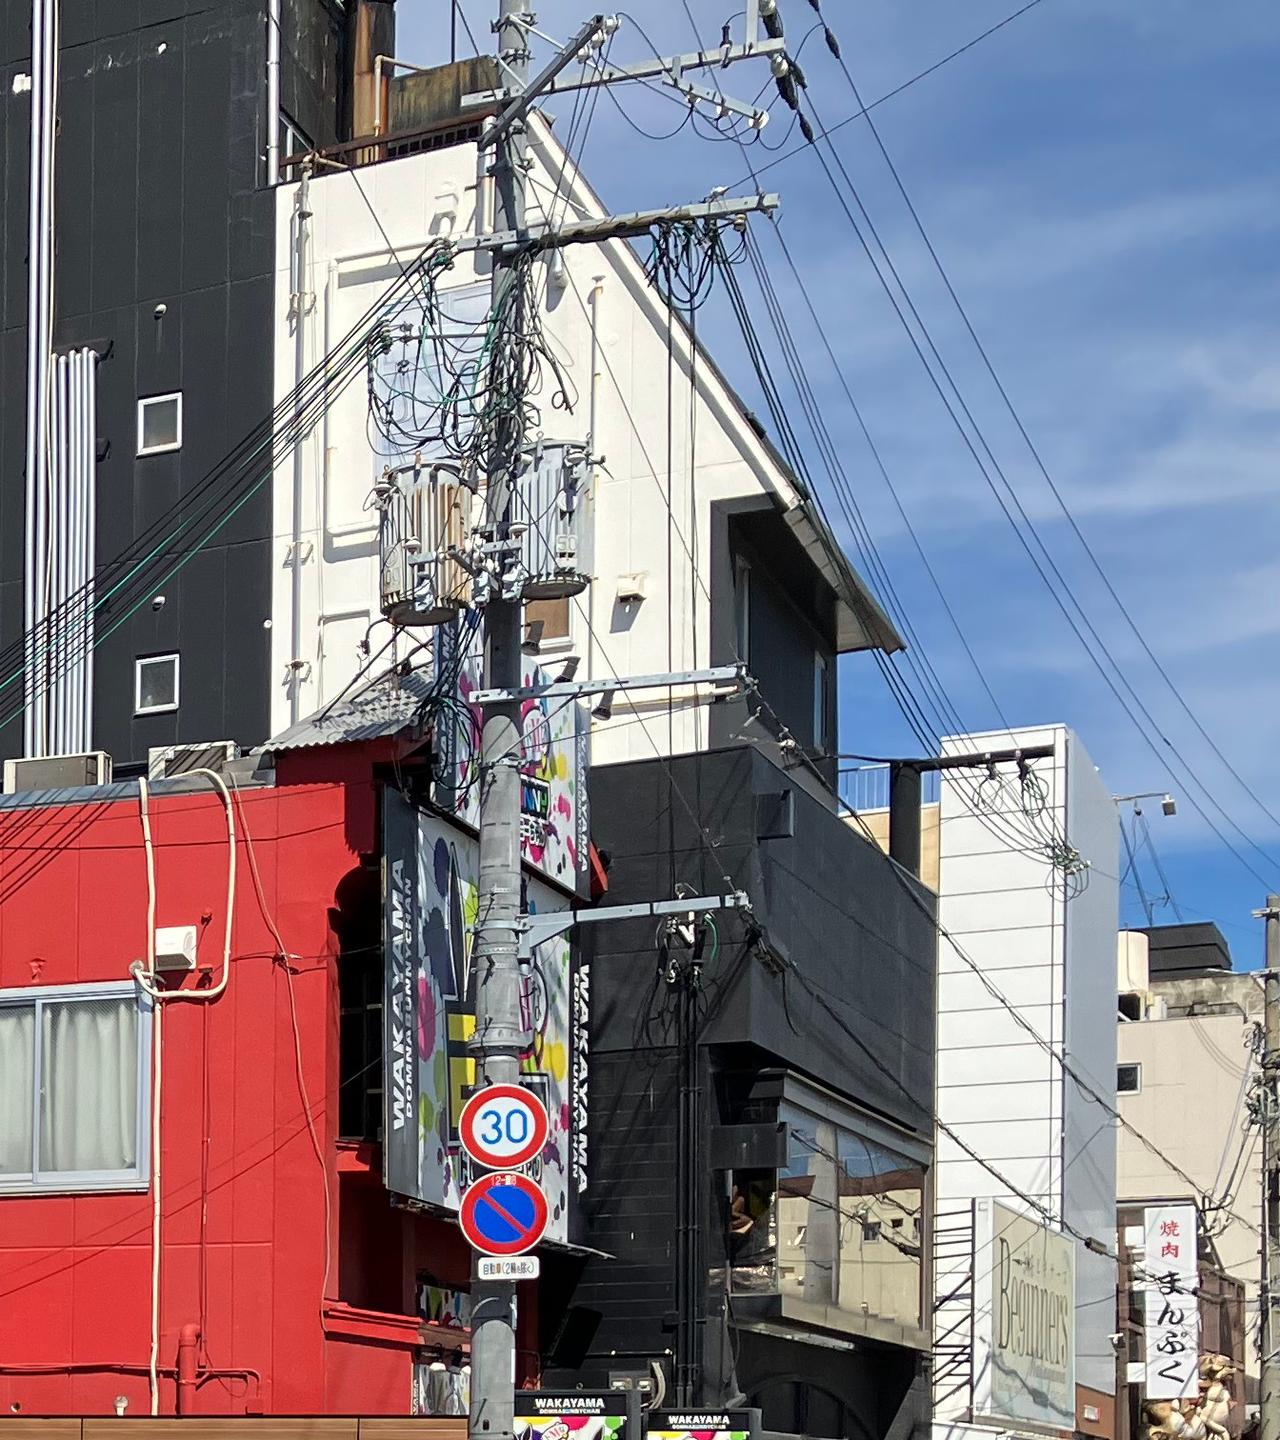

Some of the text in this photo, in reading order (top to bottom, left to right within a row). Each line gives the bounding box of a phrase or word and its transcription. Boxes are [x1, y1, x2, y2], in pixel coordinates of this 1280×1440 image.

[392, 859, 405, 1131] WAKAYAMA
[481, 1109, 528, 1144] 30
[578, 964, 590, 1194] WAKAYAMA
[1157, 1220, 1186, 1384] 焼肉 まんぷく
[535, 1398, 605, 1408] WAKAYAMA
[668, 1415, 730, 1425] WAKAYAMA
